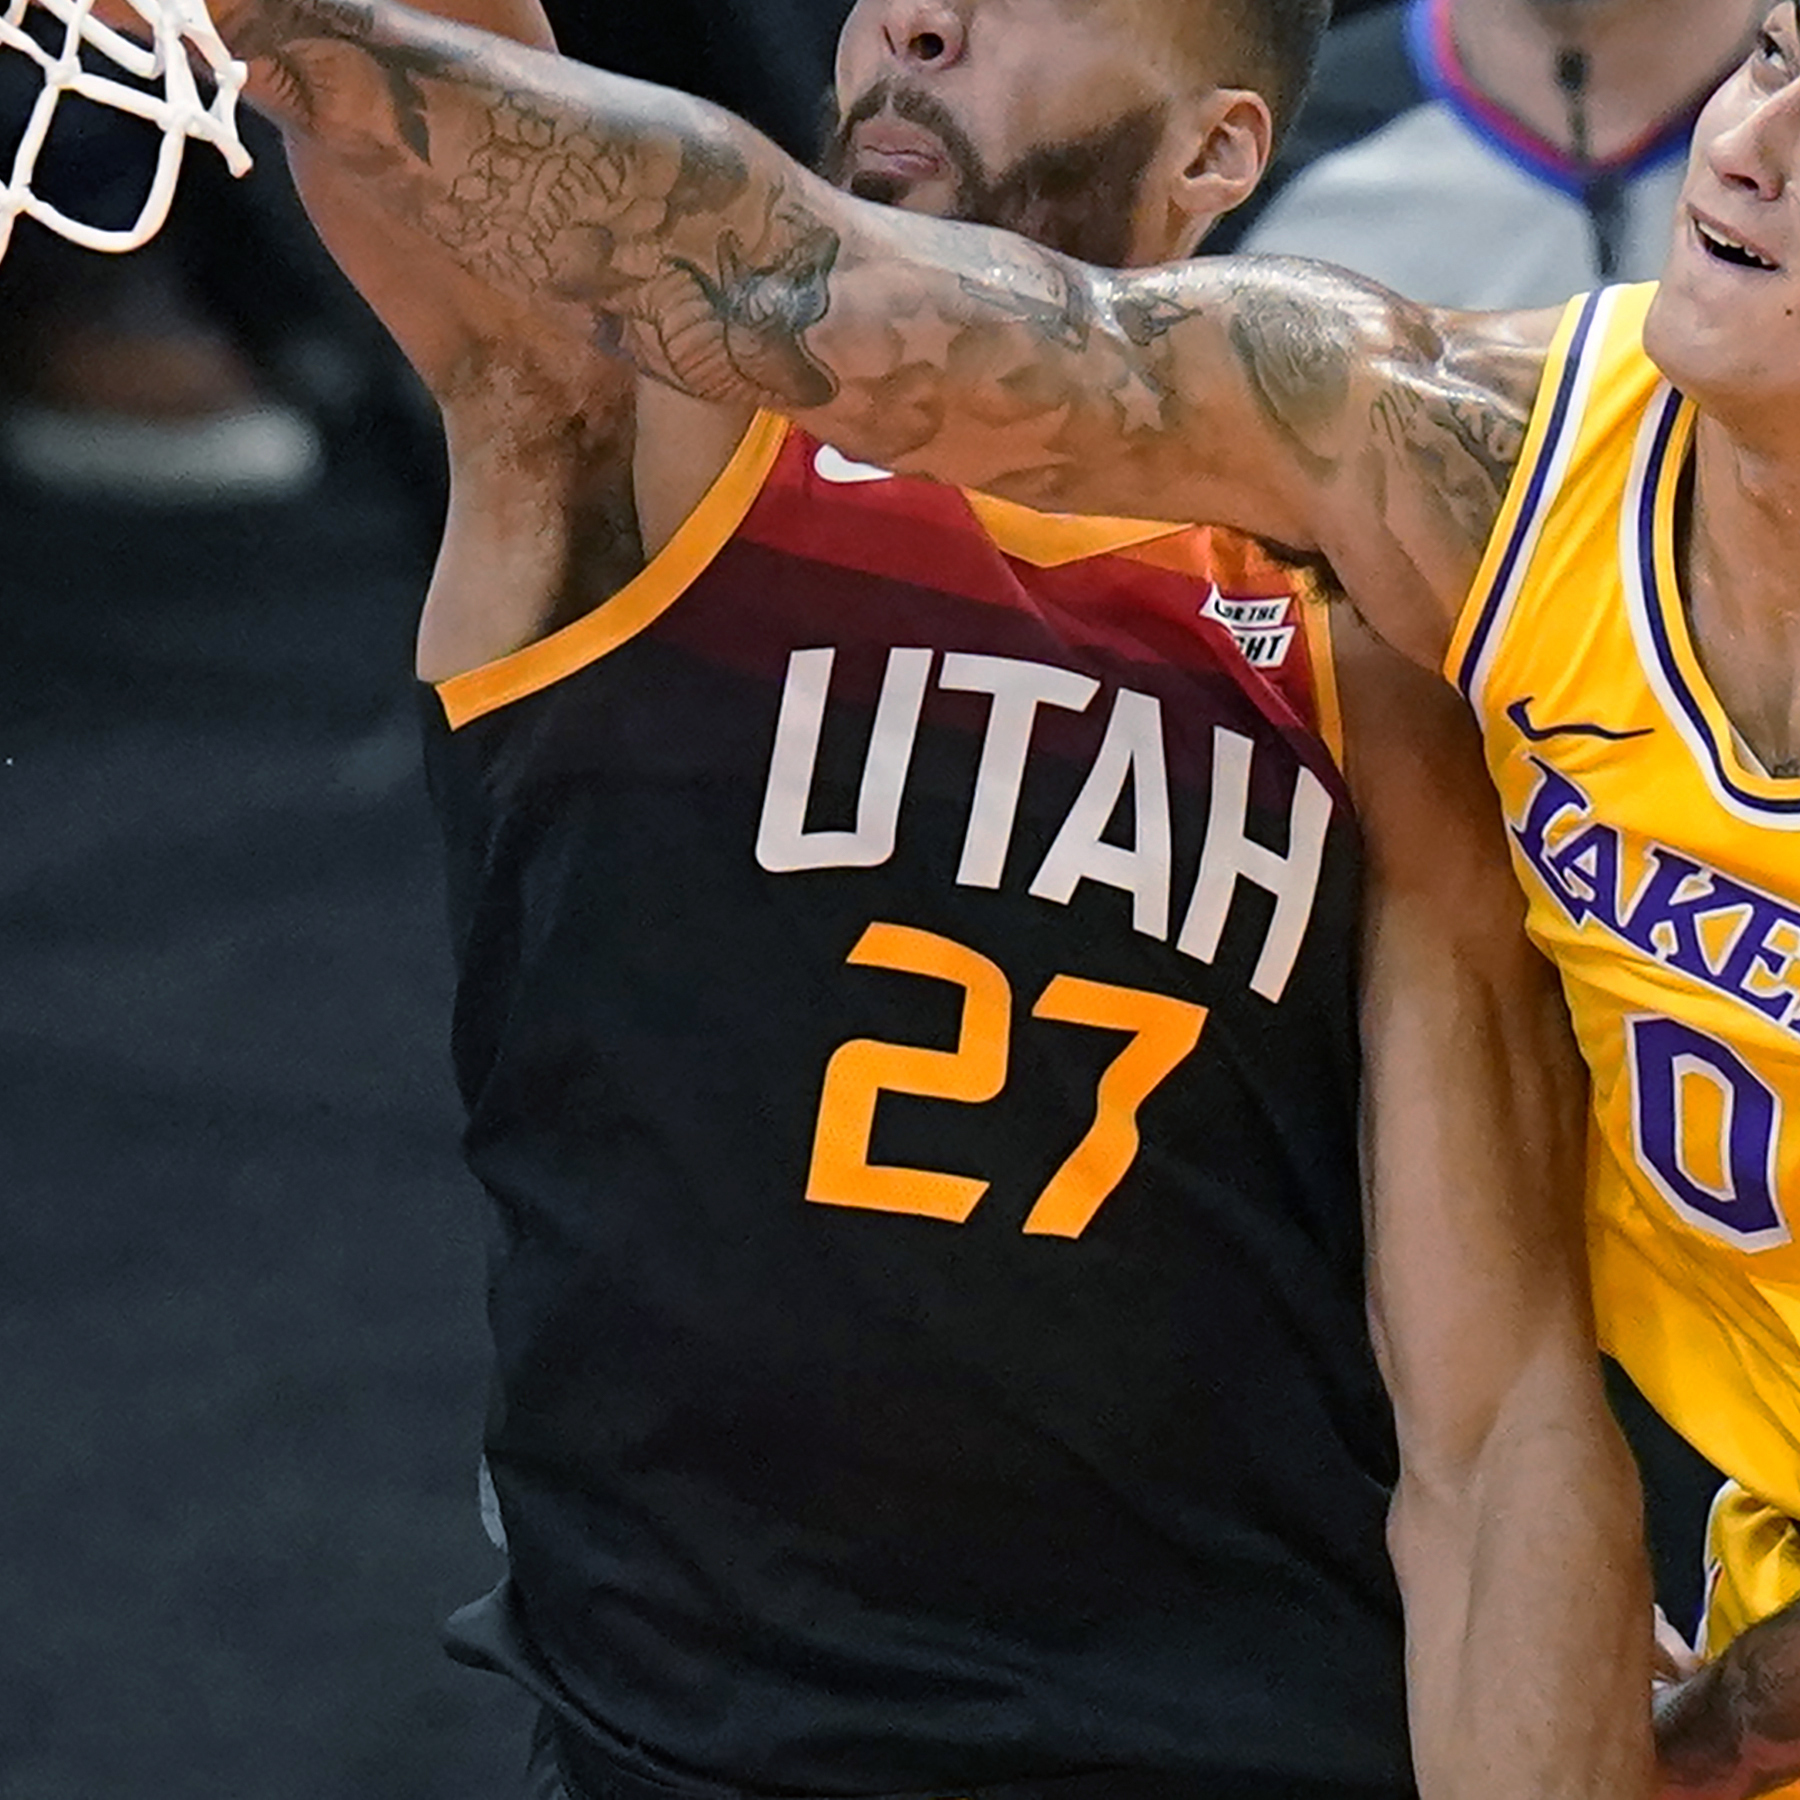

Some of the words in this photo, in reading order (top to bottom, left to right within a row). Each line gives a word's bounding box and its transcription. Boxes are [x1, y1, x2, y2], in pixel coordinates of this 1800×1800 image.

[1248, 605, 1280, 621] THE
[755, 646, 1334, 1004] UTAH
[804, 920, 1210, 1240] 27
[1624, 1009, 1792, 1255] 0
